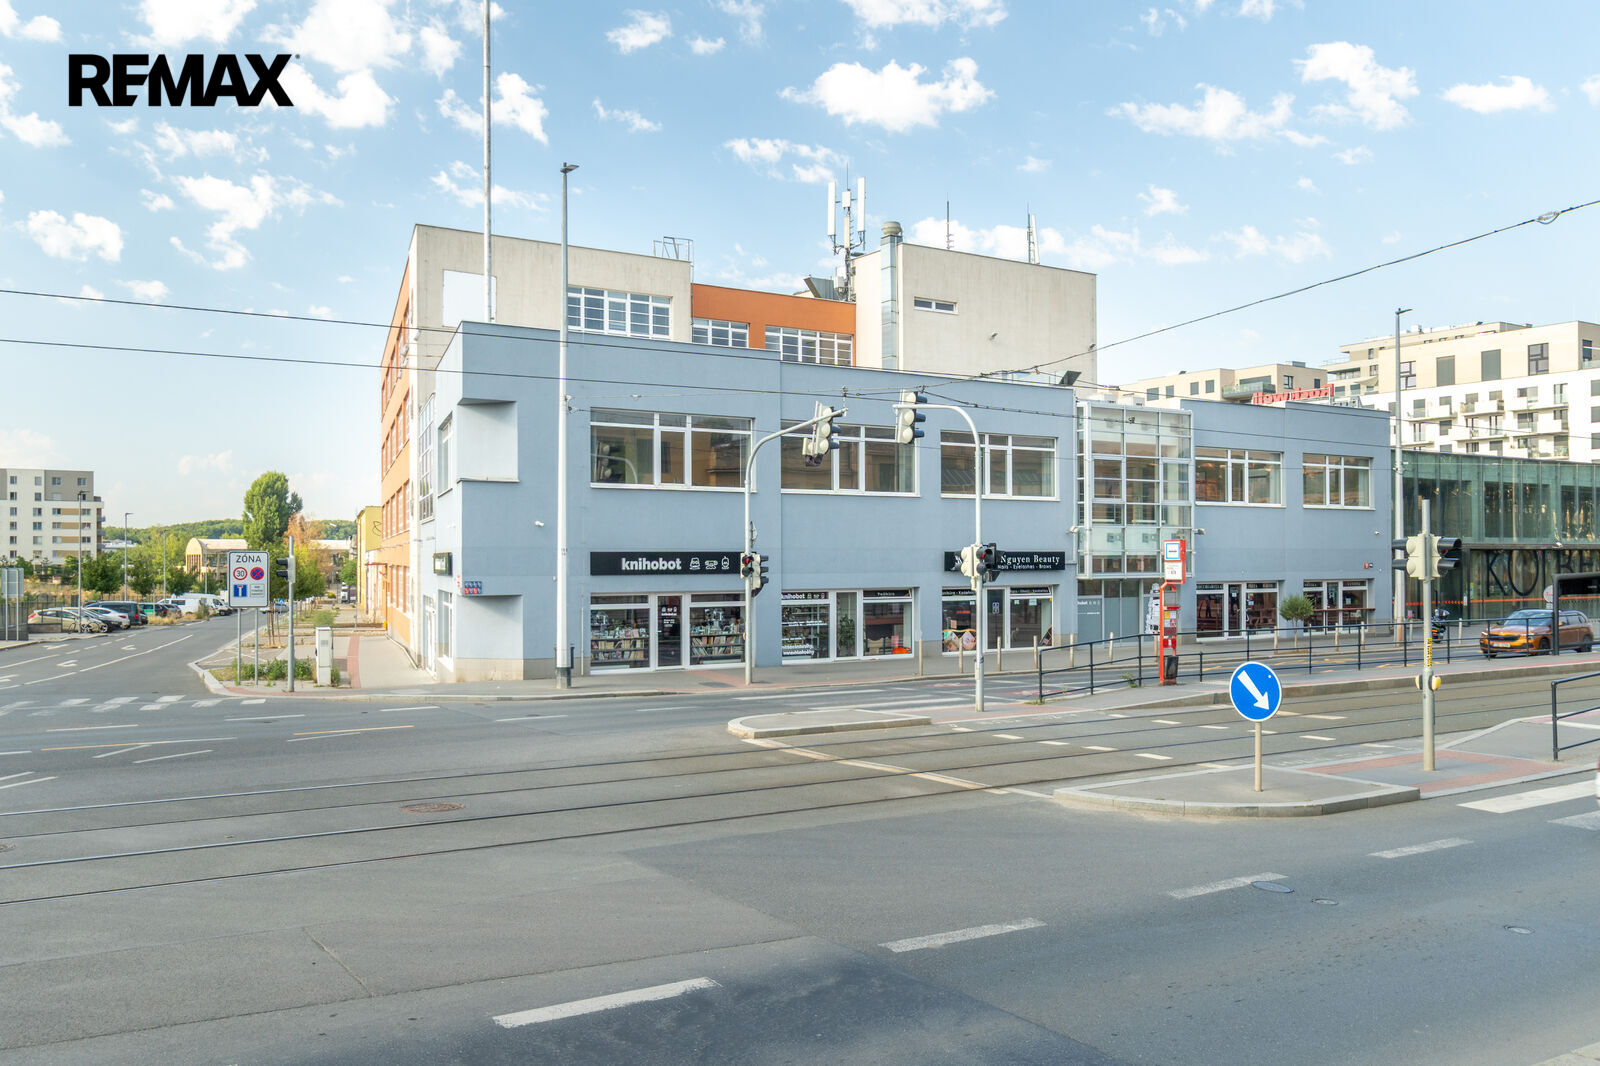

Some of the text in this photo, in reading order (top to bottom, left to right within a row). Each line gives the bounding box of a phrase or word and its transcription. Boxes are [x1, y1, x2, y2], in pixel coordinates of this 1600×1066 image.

[236, 554, 261, 563] ZÓNA
[621, 557, 682, 571] knihobot
[1000, 554, 1060, 565] Nguyen Beauty
